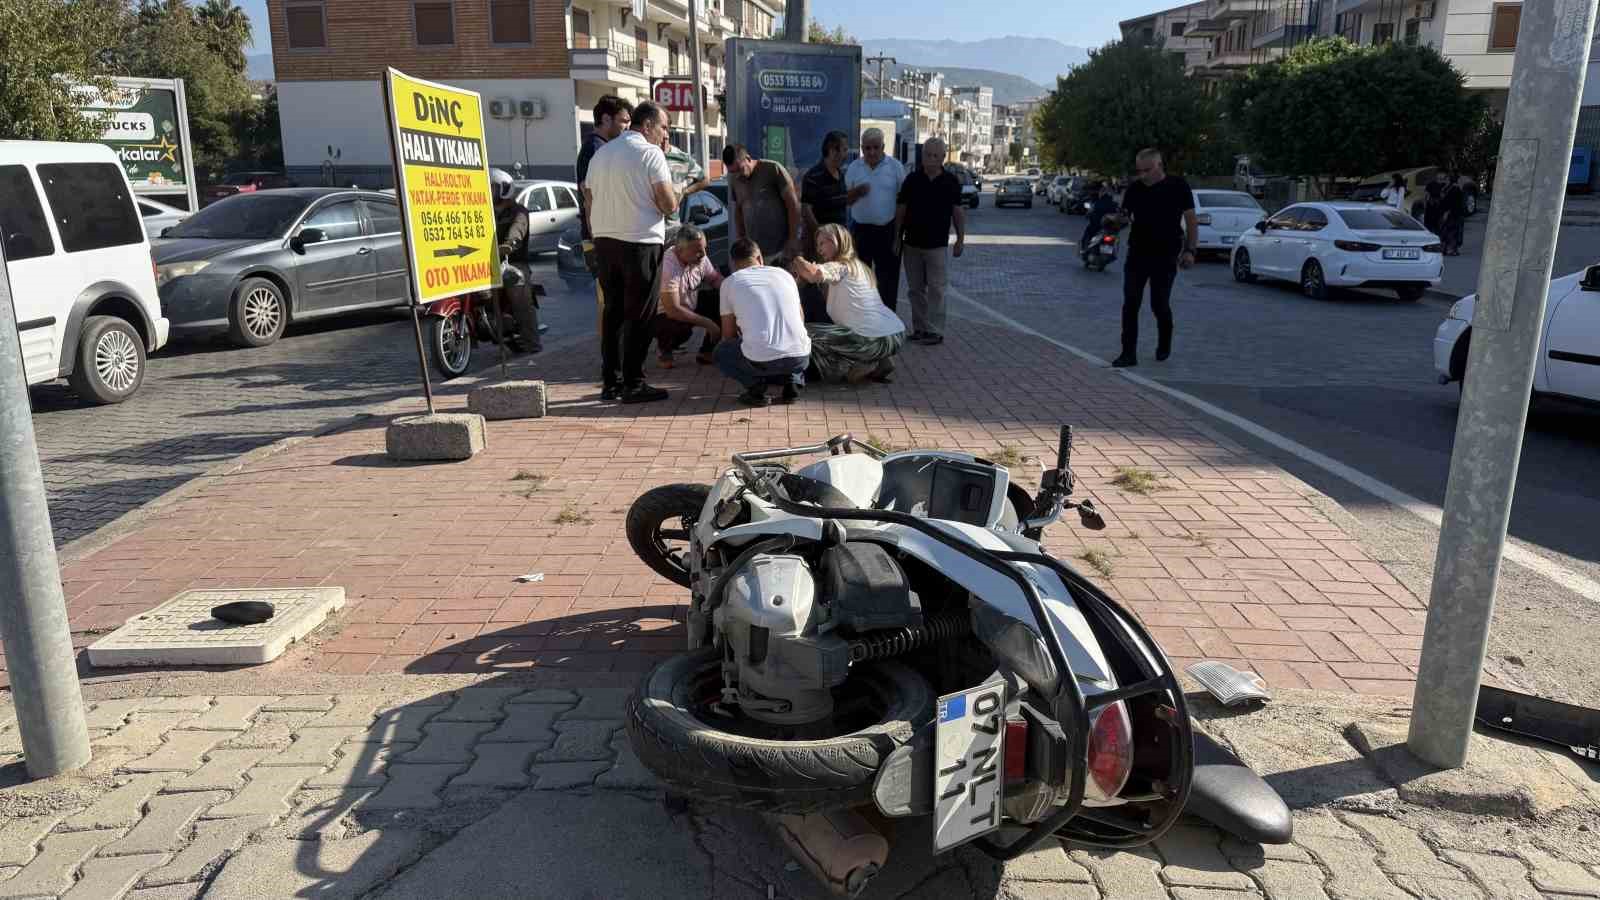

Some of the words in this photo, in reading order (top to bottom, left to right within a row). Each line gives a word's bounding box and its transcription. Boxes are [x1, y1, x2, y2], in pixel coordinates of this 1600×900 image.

[764, 74, 784, 86] 0533
[402, 132, 434, 162] HALI
[435, 137, 482, 167] YIKAMA
[424, 172, 472, 188] HALI-KOLTUK
[410, 189, 461, 206] YATAK-PERDE
[462, 191, 487, 206] YIKAMA
[421, 211, 443, 226] 0546
[445, 210, 461, 225] 466
[462, 211, 473, 225] 76
[474, 210, 484, 224] 86
[423, 227, 445, 242] 0532
[446, 225, 462, 240] 764
[464, 226, 474, 240] 54
[475, 225, 486, 238] 82
[425, 268, 450, 288] OTO
[452, 262, 494, 284] YIKAMA
[939, 703, 948, 718] TR
[971, 692, 1000, 735] 07
[939, 759, 967, 801] 11
[971, 747, 998, 826] NLT
